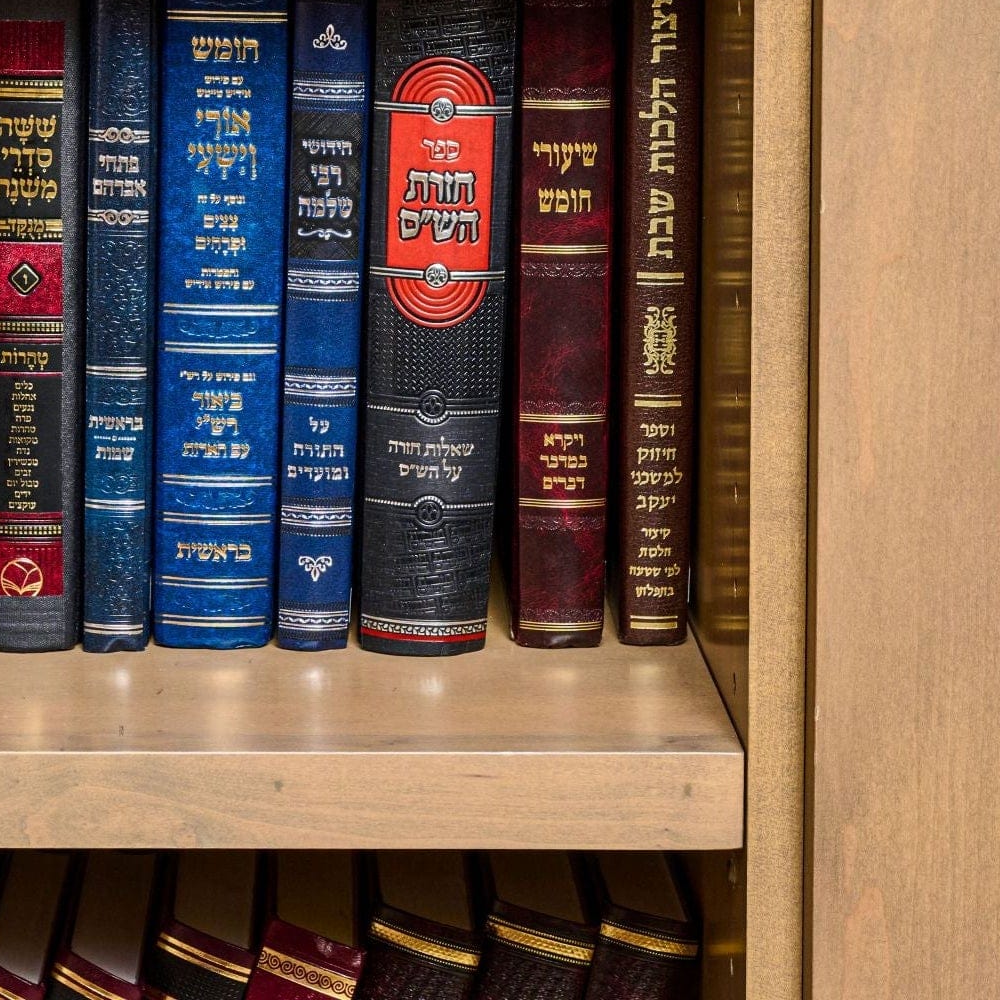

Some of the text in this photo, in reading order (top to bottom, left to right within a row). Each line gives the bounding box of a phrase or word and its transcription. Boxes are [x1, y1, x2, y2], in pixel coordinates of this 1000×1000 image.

[191, 35, 260, 63] חומש
[639, 77, 678, 174] הלכות
[302, 139, 352, 155] חידושי
[421, 138, 460, 161] ספר
[99, 154, 139, 173] פתחי
[532, 141, 598, 175] שיעורי
[310, 164, 342, 186] רבי
[93, 178, 147, 197] אברהם
[403, 168, 476, 204] חזרת
[298, 188, 352, 218] שלמה
[538, 188, 592, 213] חומש
[647, 188, 675, 259] שבת
[15, 380, 33, 390] כלים
[11, 392, 36, 400] אהלות
[191, 390, 243, 411] ביאור
[14, 404, 34, 412] נגעים
[89, 415, 143, 432] בראשית
[309, 416, 330, 434] על
[640, 423, 675, 437] וספר
[293, 442, 344, 458] התורה
[388, 436, 475, 458] שאלות חזרה
[543, 433, 583, 452] ויקרא
[96, 444, 134, 462] שמות
[540, 455, 588, 469] במדבר
[637, 446, 677, 464] חיזוק
[287, 465, 349, 482] ומועדים
[443, 458, 462, 483] על
[543, 476, 585, 490] דברים
[8, 501, 36, 511] עוקצים
[636, 495, 676, 512] יעקב
[641, 527, 671, 540] קיצור
[176, 541, 252, 562] בראשית
